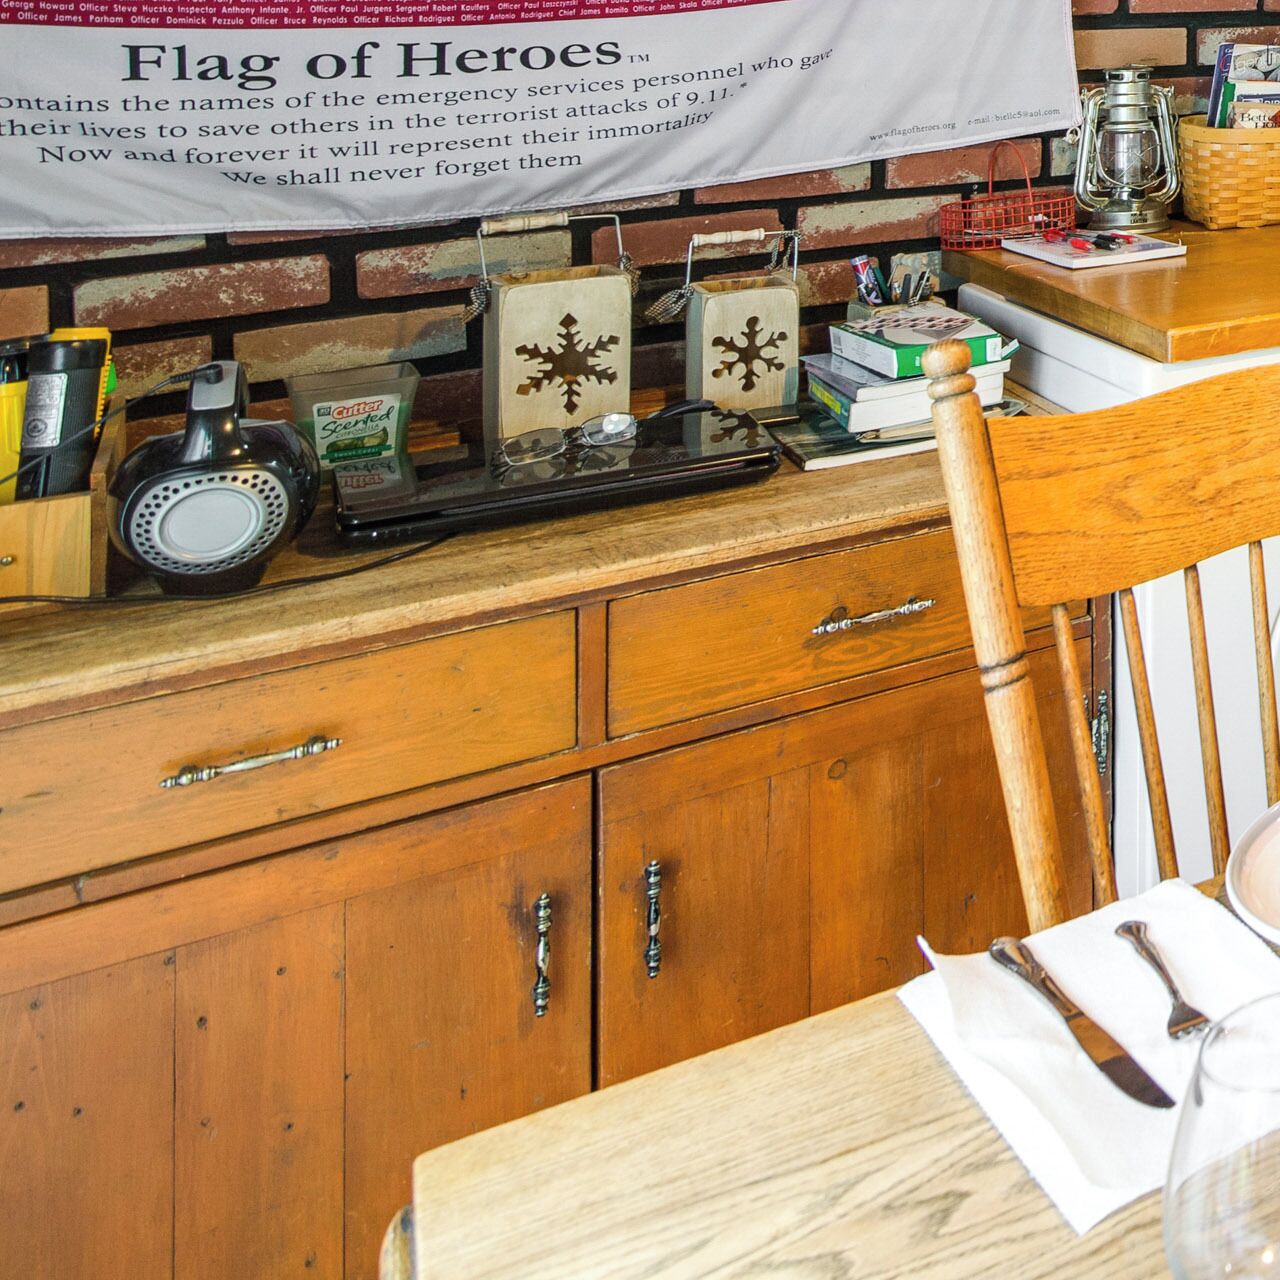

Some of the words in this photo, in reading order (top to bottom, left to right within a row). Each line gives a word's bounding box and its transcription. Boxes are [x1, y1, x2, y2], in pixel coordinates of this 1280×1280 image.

[0, 96, 109, 111] ontains
[122, 95, 169, 112] the
[180, 95, 274, 112] names
[286, 92, 315, 110] of
[322, 91, 365, 108] the
[376, 86, 519, 108] emergency
[528, 79, 625, 96] services
[633, 63, 743, 92] personnel
[752, 55, 793, 73] who
[801, 48, 833, 70] gave
[122, 44, 280, 91] Flag
[307, 42, 379, 79] of
[397, 41, 623, 77] Heroes
[0, 120, 71, 136] their
[78, 122, 146, 139] lives
[158, 124, 187, 138] to
[198, 122, 260, 138] save
[271, 118, 359, 135] others
[368, 115, 393, 131] in
[405, 114, 448, 129] the
[456, 106, 559, 125] terrorist
[566, 98, 648, 119] attacks
[657, 93, 680, 110] of
[870, 121, 956, 141] www.flagofheroes.org
[38, 146, 112, 163] Now
[125, 149, 177, 162] and
[186, 146, 289, 164] forever
[299, 144, 319, 159] it
[328, 141, 379, 158] will
[389, 134, 513, 157] represent
[522, 128, 580, 145] their
[588, 110, 713, 141] immortality
[221, 171, 267, 186] We
[276, 167, 341, 187] shall
[350, 164, 425, 184] never
[434, 157, 510, 179] forget
[519, 153, 582, 169] them
[320, 405, 395, 439] Scented
[332, 400, 384, 420] Cutter
